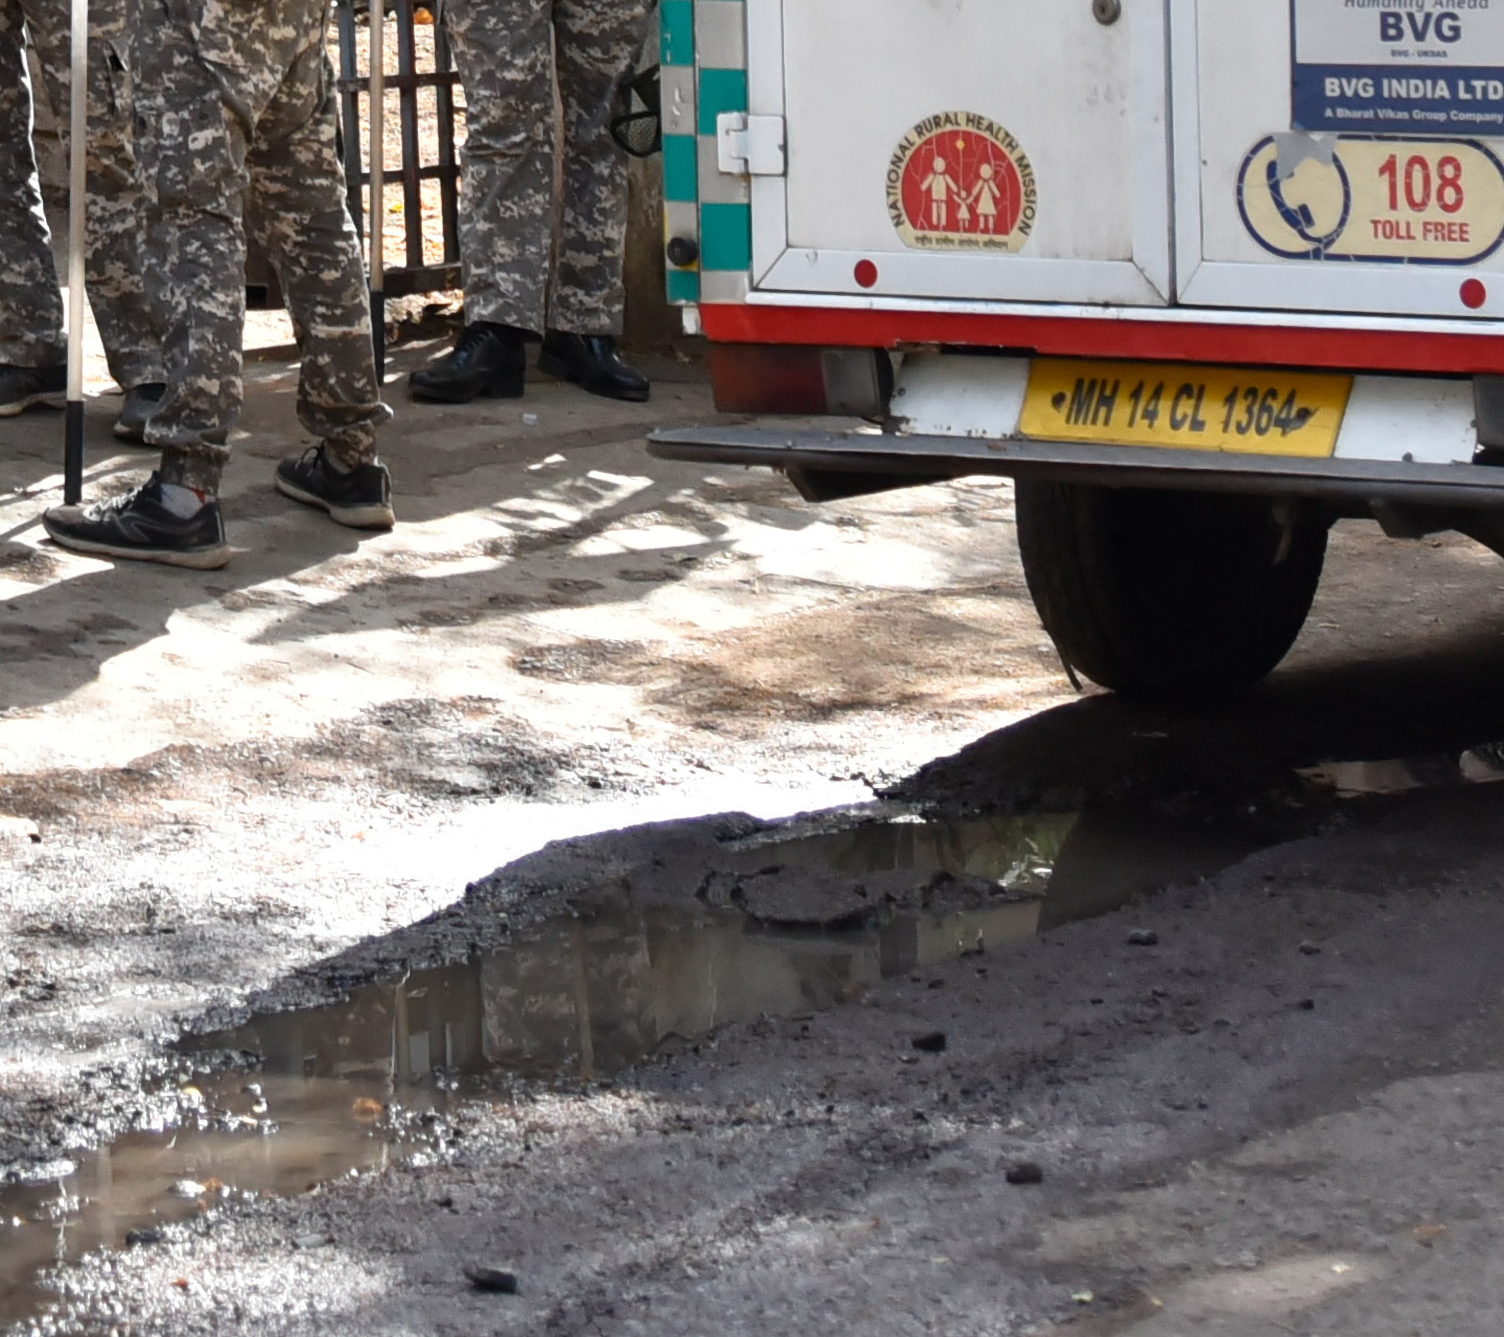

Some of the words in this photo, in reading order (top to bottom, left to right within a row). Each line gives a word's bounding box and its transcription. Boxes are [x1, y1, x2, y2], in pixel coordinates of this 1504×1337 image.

[1379, 10, 1462, 44] BVG
[1324, 77, 1375, 98] BVG
[1383, 78, 1451, 100] INDIA
[1336, 108, 1376, 119] Bharat
[1413, 110, 1447, 123] Group
[1450, 110, 1504, 124] Company
[887, 136, 917, 228] NATIONAL
[914, 112, 962, 139] RURAL
[965, 112, 1020, 155] HEALTH
[1014, 153, 1038, 237] MISSION
[1378, 154, 1464, 214] 108
[1370, 219, 1417, 240] TOLL
[1422, 221, 1470, 242] FREE
[1065, 378, 1121, 427] MH
[1127, 380, 1164, 429] 14
[1168, 382, 1208, 433] CL
[1221, 385, 1299, 437] 1364
